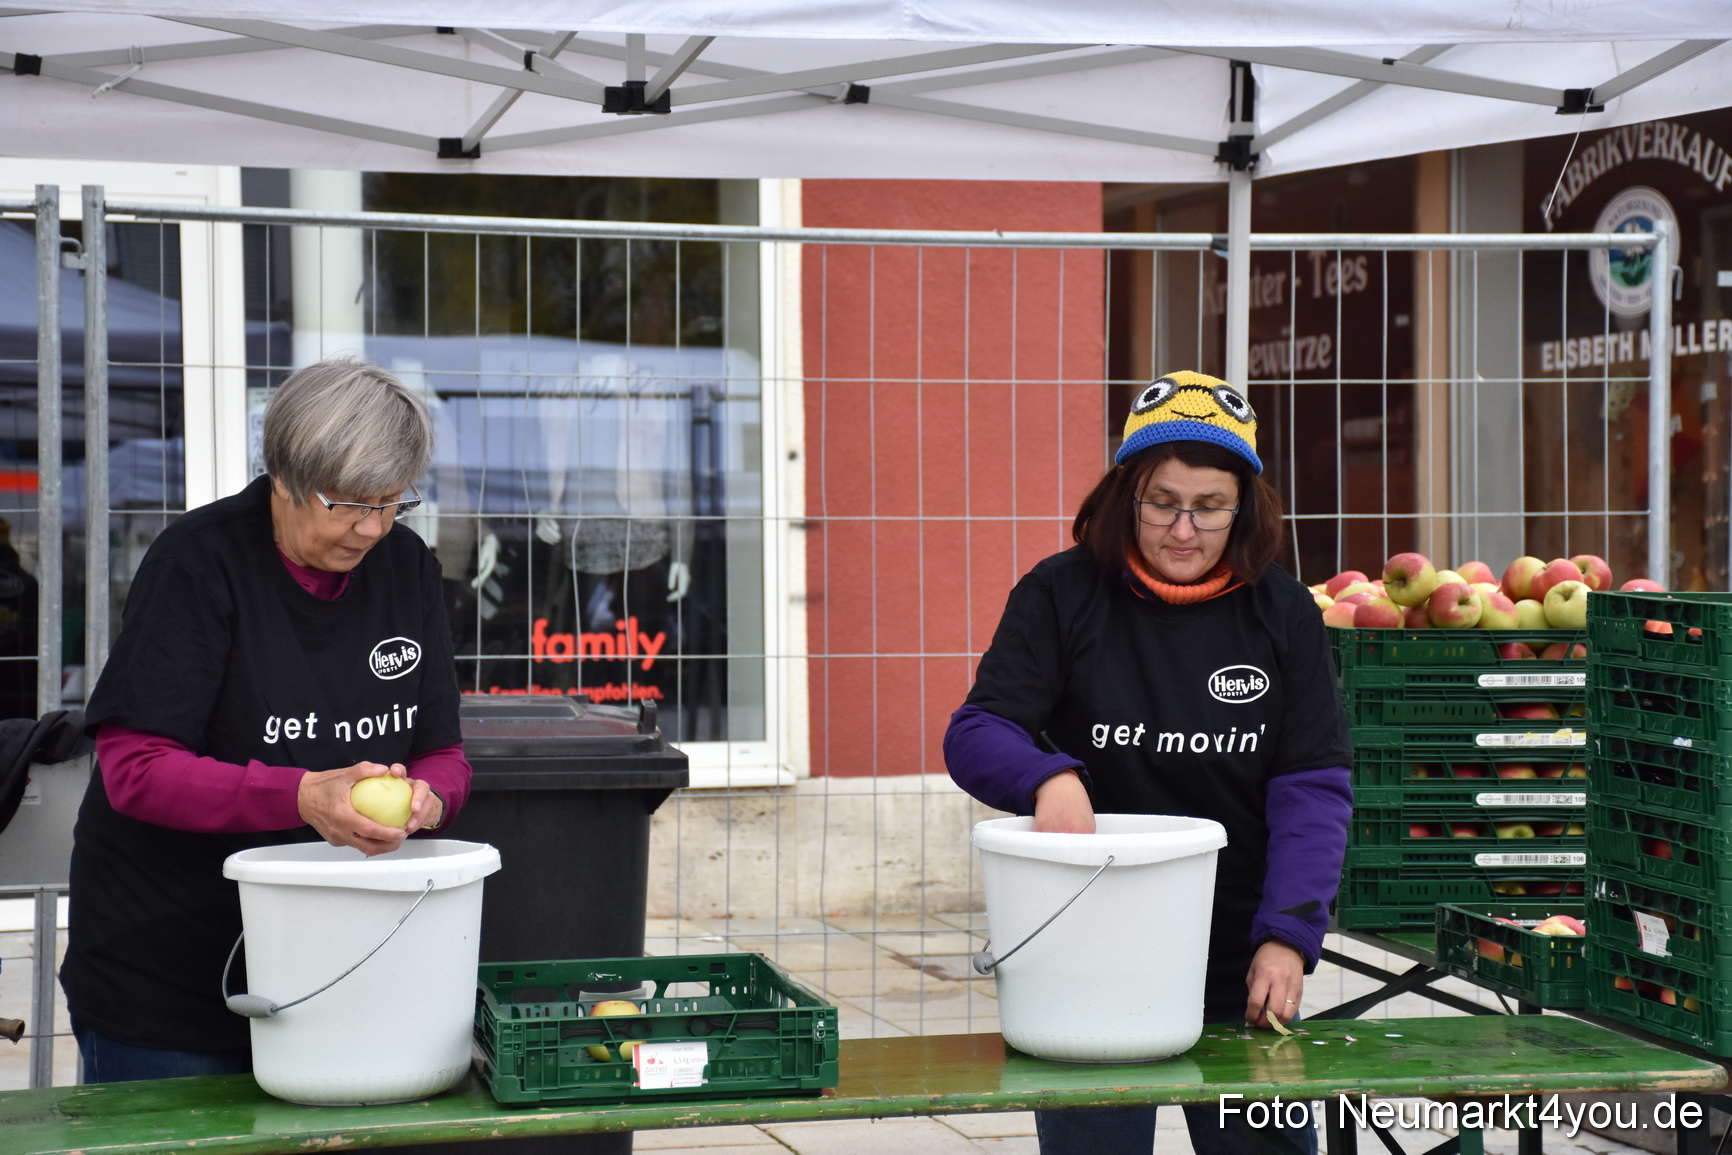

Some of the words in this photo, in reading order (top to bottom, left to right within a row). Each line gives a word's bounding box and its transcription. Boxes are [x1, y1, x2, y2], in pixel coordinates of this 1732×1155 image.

[1540, 120, 1732, 232] FABRIKVERKAUF
[1309, 250, 1368, 298] Tees
[1249, 325, 1332, 377] ewürze
[1541, 331, 1635, 373] ELSBETH
[374, 646, 417, 670] Hervis
[532, 616, 667, 671] family
[1214, 674, 1264, 695] Hervis
[1218, 690, 1243, 698] SPORTS
[263, 712, 318, 744] get
[1092, 722, 1146, 749] get
